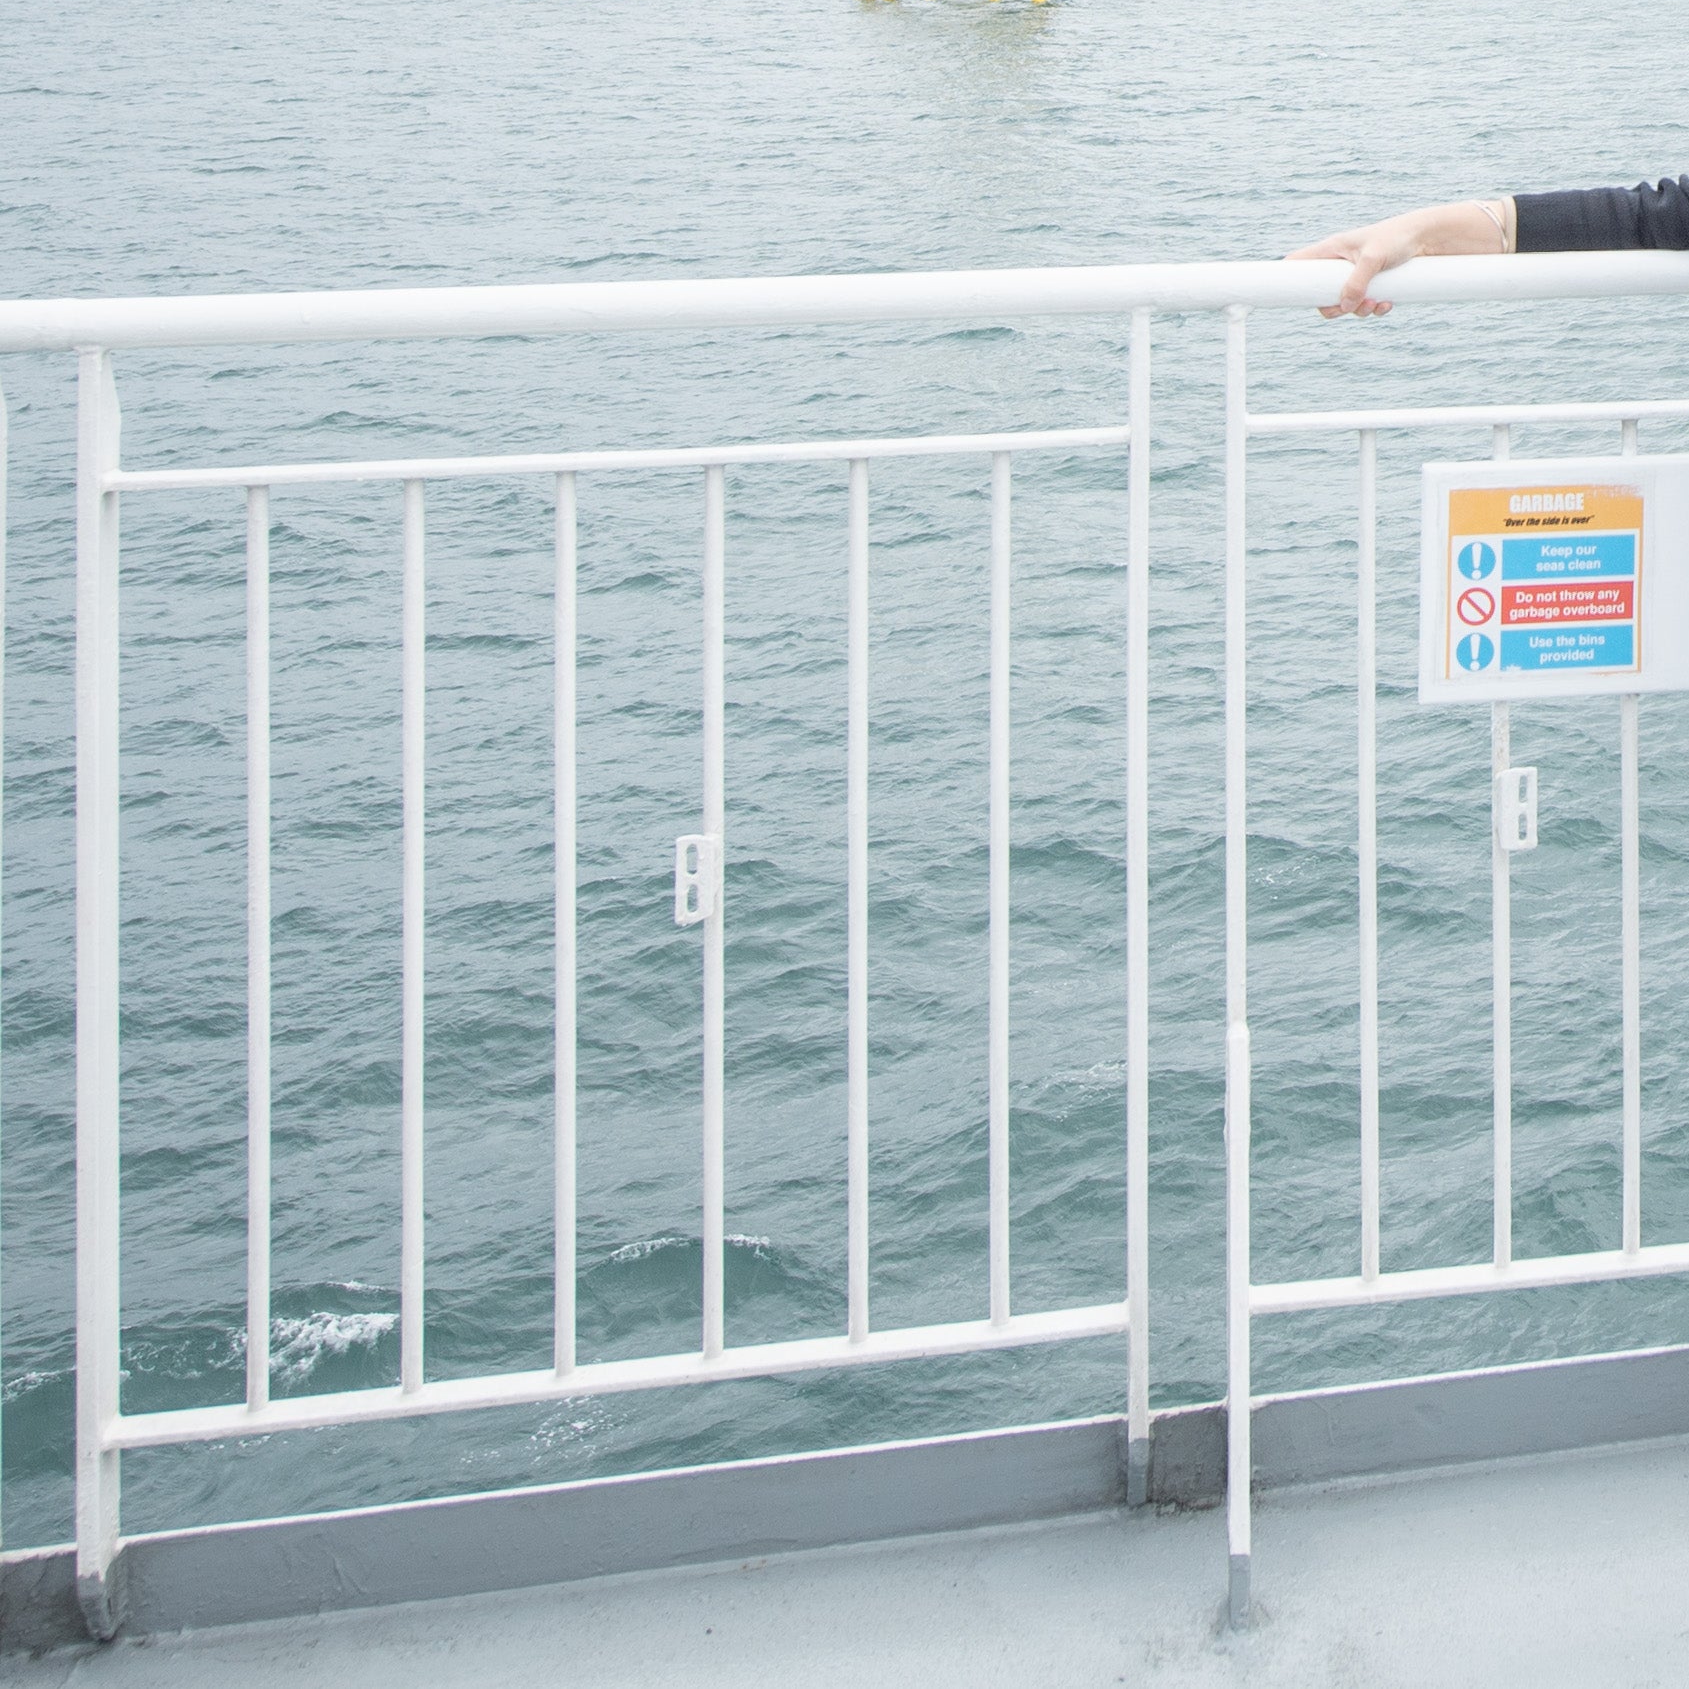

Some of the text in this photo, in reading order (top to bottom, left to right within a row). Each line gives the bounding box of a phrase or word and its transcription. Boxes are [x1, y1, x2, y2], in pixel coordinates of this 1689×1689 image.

[1510, 493, 1584, 513] GARBAGE
[1525, 516, 1540, 526] the
[1541, 516, 1560, 526] side
[1561, 515, 1570, 525] is
[1541, 545, 1597, 559] Keep our
[1536, 559, 1601, 572] seas clean
[1515, 589, 1620, 603] Do not throw any
[1509, 602, 1625, 621] garbage overboard
[1529, 633, 1605, 648] Use the bins
[1540, 649, 1594, 664] provided
